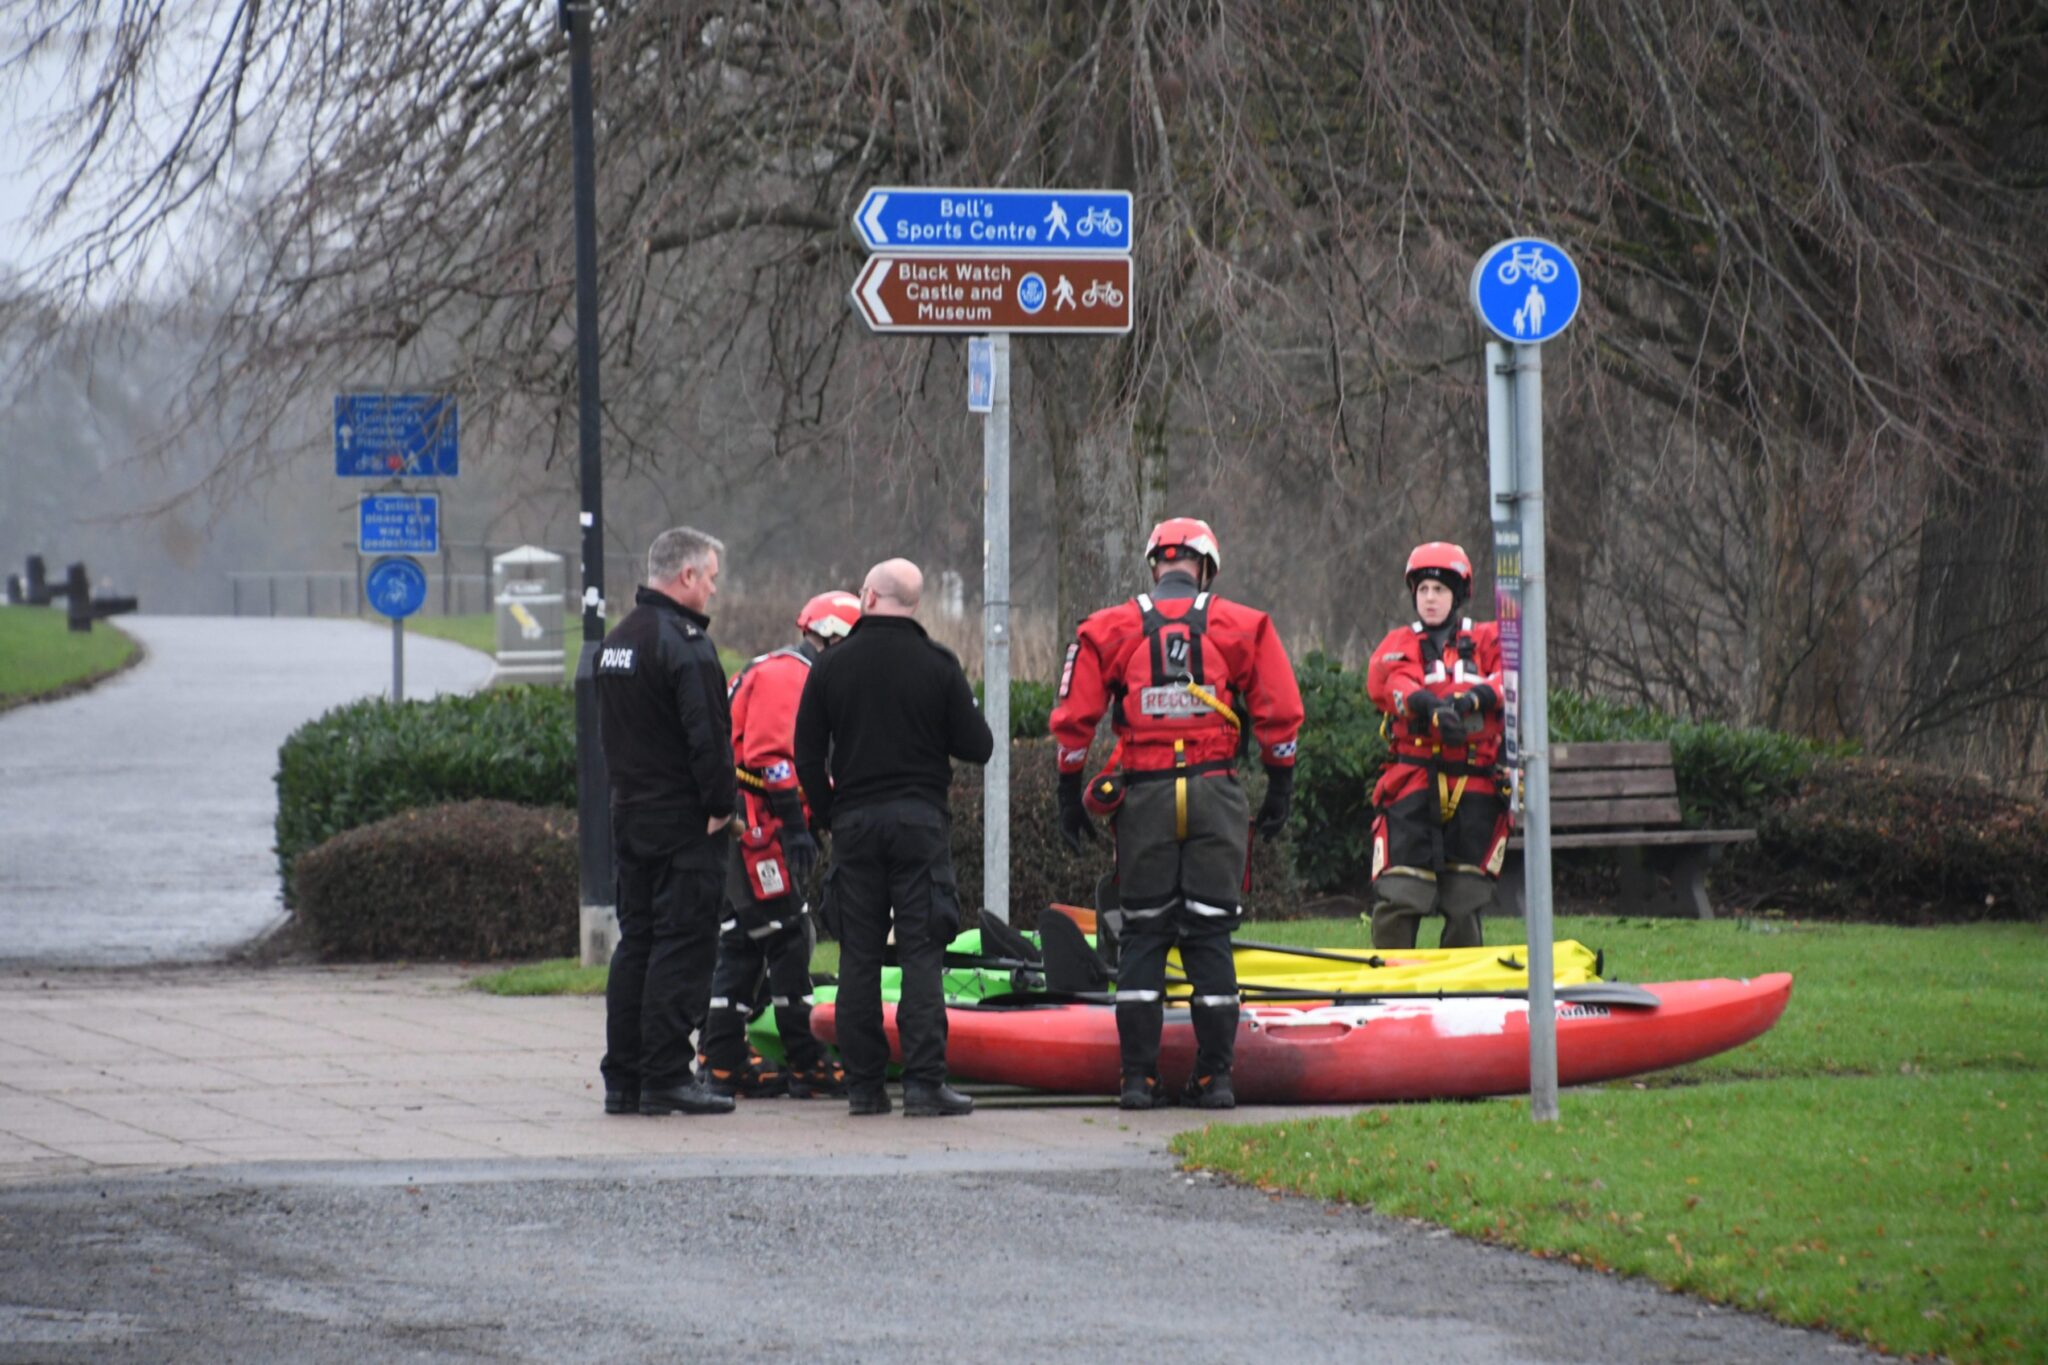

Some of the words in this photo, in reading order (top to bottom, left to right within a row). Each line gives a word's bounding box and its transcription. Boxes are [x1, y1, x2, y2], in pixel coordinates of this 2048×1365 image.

[940, 199, 994, 218] Bell's
[896, 221, 962, 241] Sports
[970, 222, 1037, 241] Centre
[899, 264, 948, 280] Black
[956, 264, 1012, 281] Watch
[906, 284, 964, 301] Castle
[971, 284, 1003, 301] and
[918, 304, 992, 320] Museum
[600, 647, 633, 669] POLICE
